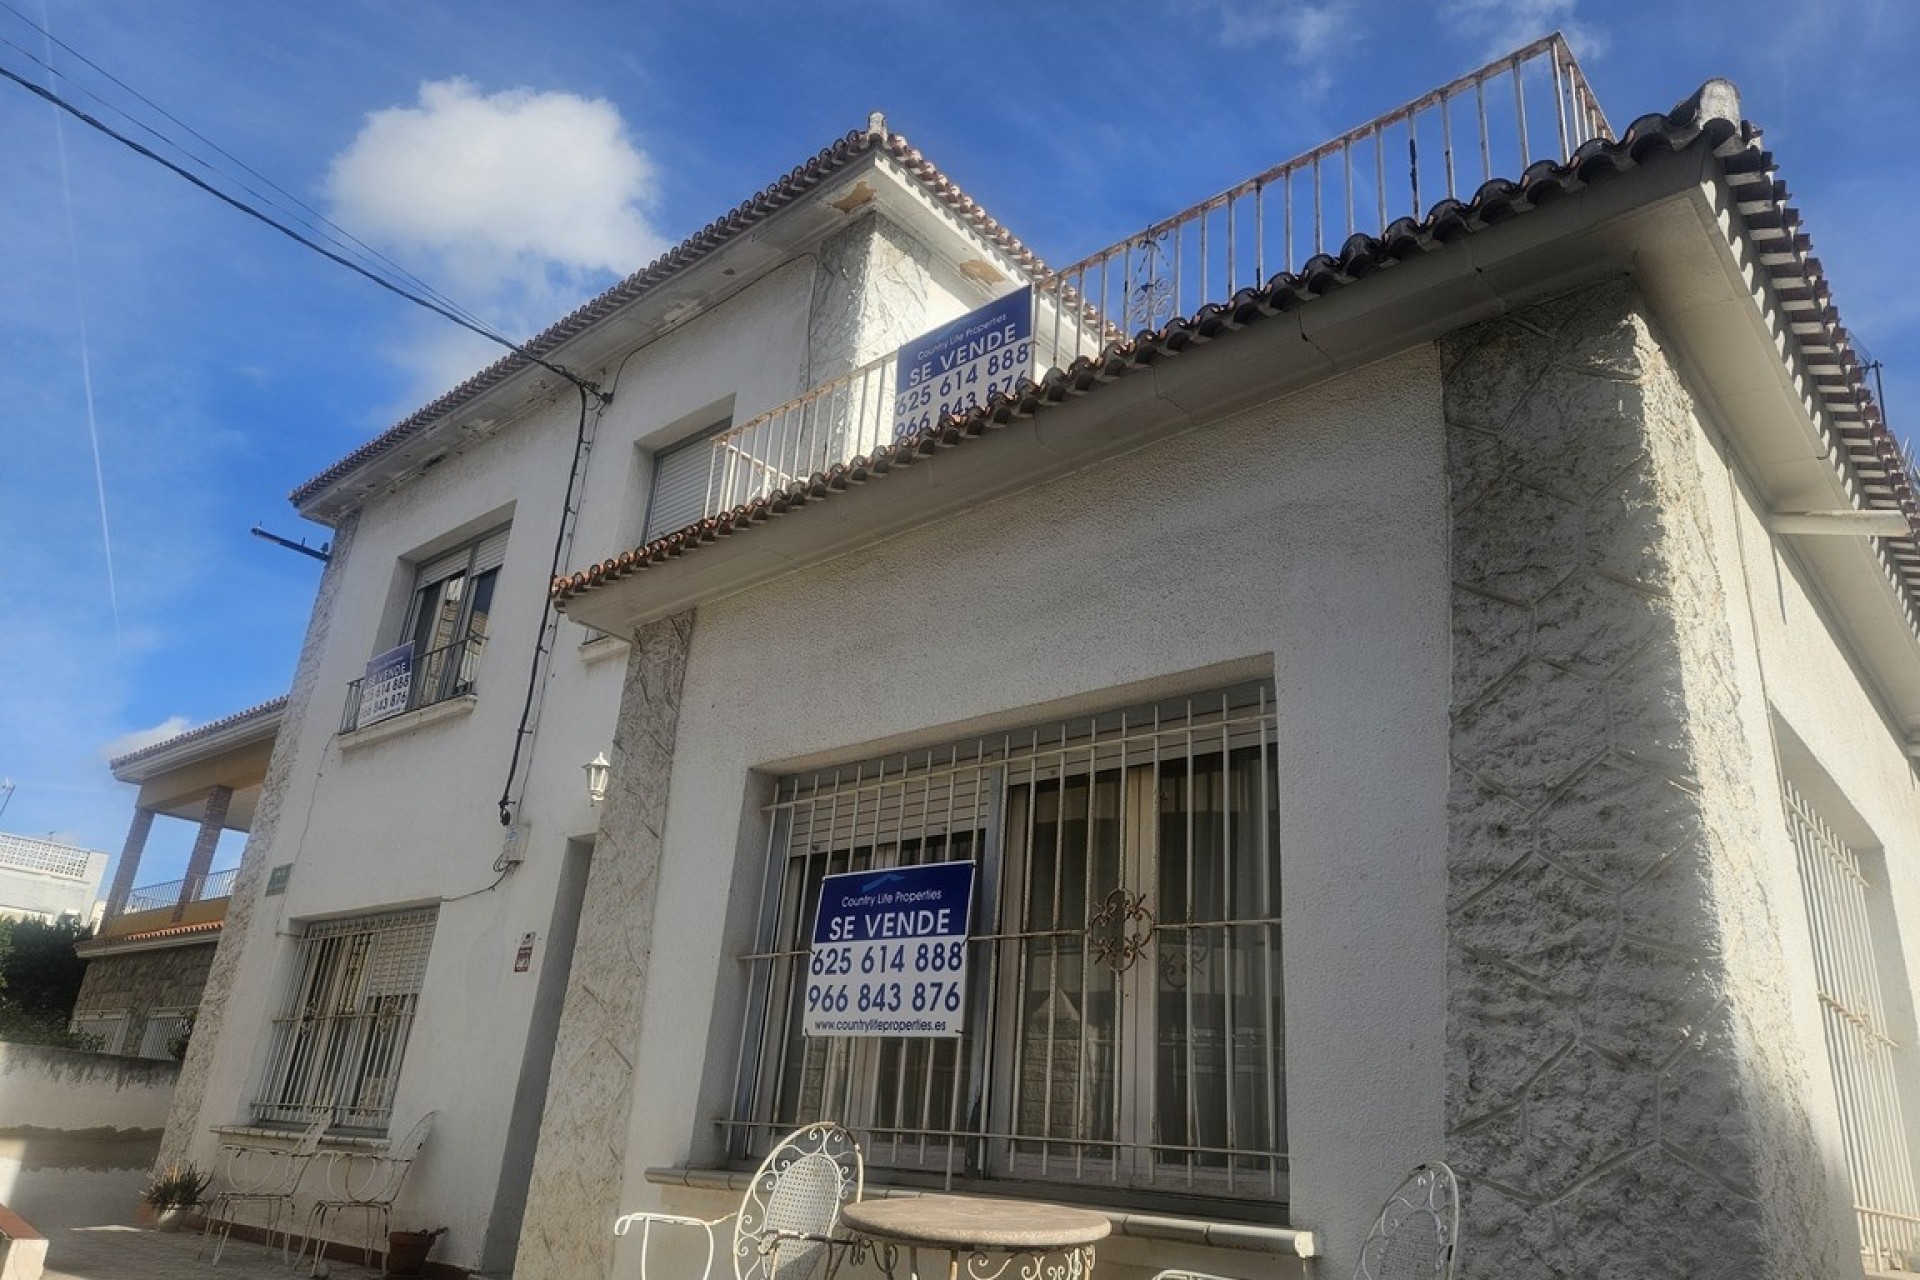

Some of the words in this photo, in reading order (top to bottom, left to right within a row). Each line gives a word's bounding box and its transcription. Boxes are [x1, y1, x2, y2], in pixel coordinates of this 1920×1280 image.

[909, 362, 931, 386] SE
[940, 323, 1016, 371] VENDE
[895, 385, 931, 416] 625
[940, 364, 978, 397] 614
[987, 343, 1029, 376] 888
[841, 895, 875, 908] Country
[878, 893, 893, 904] Life
[895, 890, 942, 904] Properties
[829, 915, 856, 940] SE
[865, 908, 951, 937] VENDE
[812, 948, 851, 975] 625
[861, 945, 904, 973] 614
[915, 942, 962, 972] 888
[808, 984, 848, 1012] 966
[858, 983, 901, 1012] 843
[912, 982, 960, 1012] 876
[815, 1018, 946, 1033] www.countrylifeproperties.es
